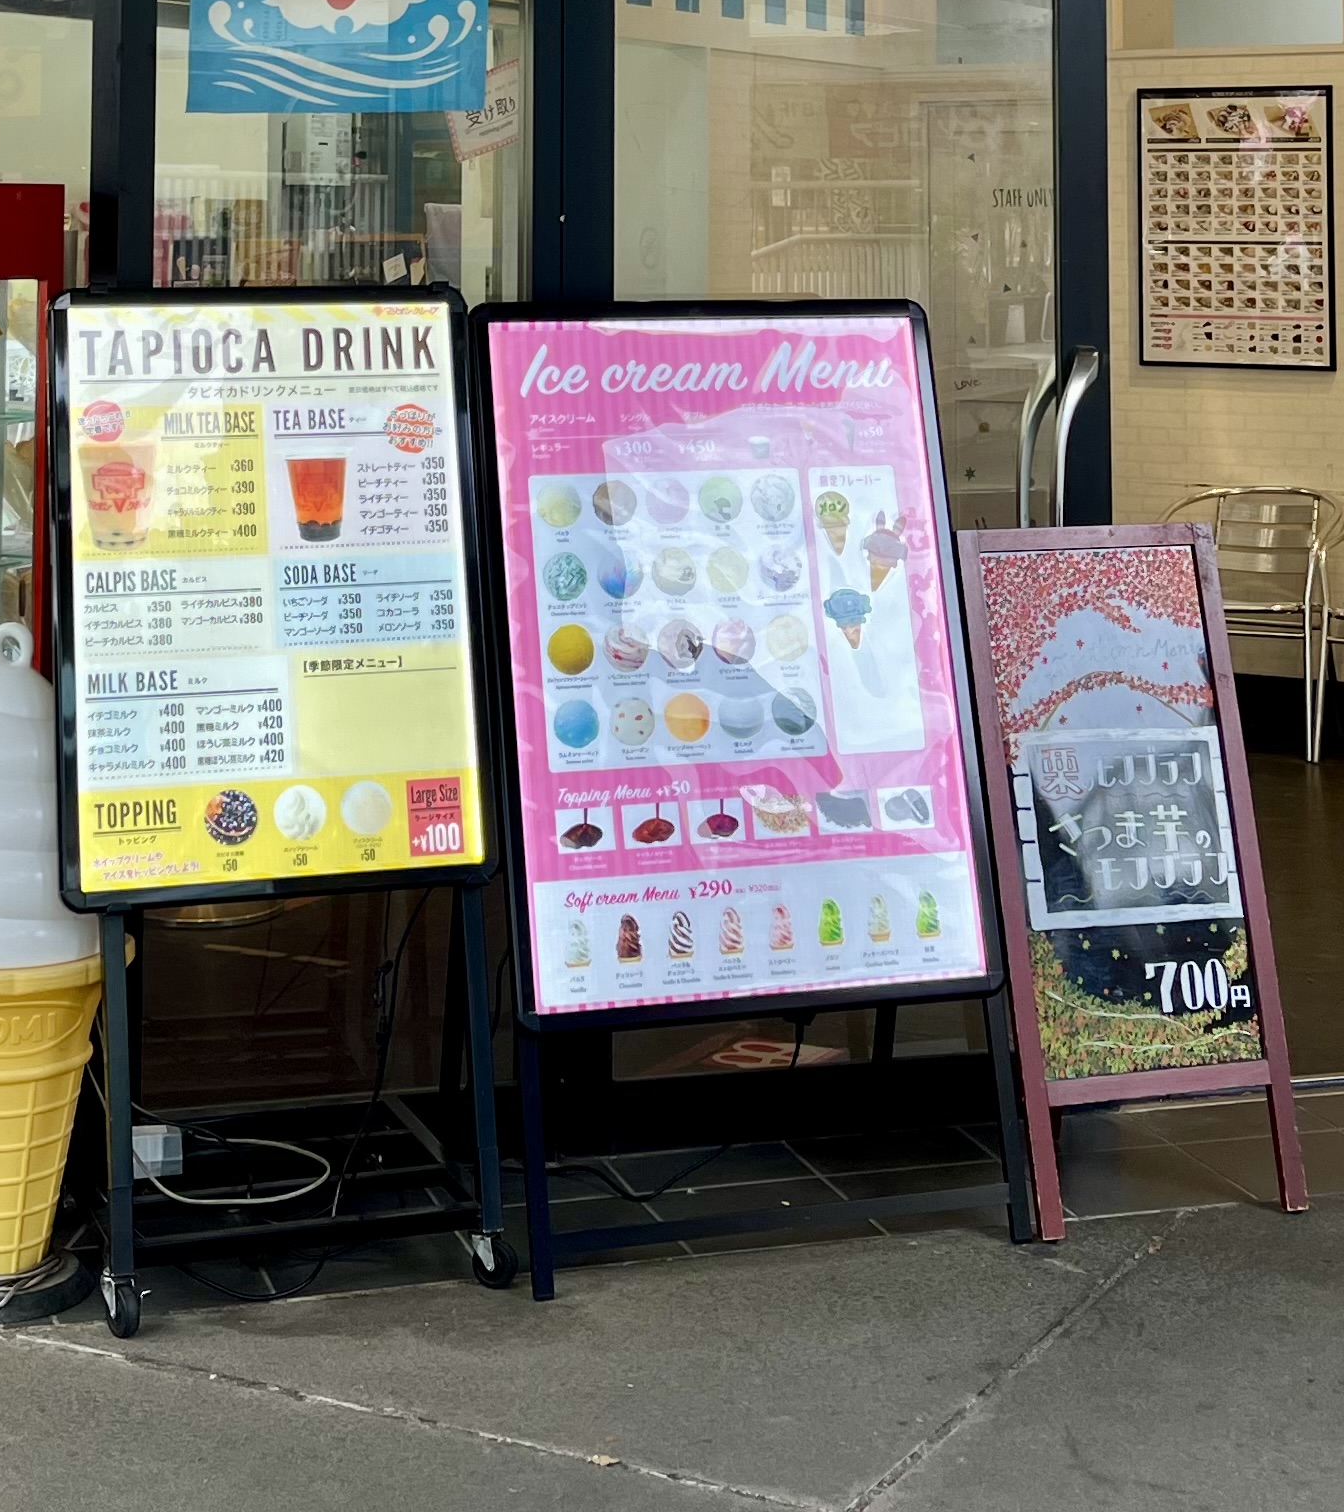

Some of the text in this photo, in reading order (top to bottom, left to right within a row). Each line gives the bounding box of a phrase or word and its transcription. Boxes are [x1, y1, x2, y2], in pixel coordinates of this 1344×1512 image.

[465, 96, 516, 128] 受け取り
[992, 188, 1022, 208] STAFF
[79, 326, 436, 375] TAPIOCA DRINK
[522, 341, 895, 398] Ice cream Menu
[187, 384, 337, 399] タピオカドリンクメニュー
[164, 411, 255, 434] MILK TEA BASE
[273, 408, 346, 431] TEA BASE
[529, 414, 596, 425] アイスクリーム
[230, 459, 254, 472] ¥360
[357, 456, 445, 473] ストレートティー ¥350
[422, 472, 446, 485] ¥350
[231, 480, 255, 494] ¥390
[358, 487, 447, 504] ライチティー ¥350
[232, 502, 256, 515] ¥390
[359, 503, 448, 519] マンゴーティー ¥350
[232, 524, 257, 537] ¥400
[360, 519, 449, 535] イチゴティー ¥350
[86, 569, 177, 594] CALPIS BASE
[284, 563, 357, 585] SODA BASE
[239, 596, 263, 608] ¥380
[338, 592, 362, 605] ¥350
[429, 589, 453, 601] ¥350
[147, 601, 172, 613] ¥350
[338, 607, 362, 619] ¥350
[376, 604, 454, 617] コカコーラ ¥350
[147, 617, 172, 629] ¥380
[239, 612, 263, 624] ¥380
[431, 619, 455, 631] ¥350
[284, 623, 363, 636] マンゴーソーダ ¥350
[148, 634, 173, 646] ¥380
[303, 655, 403, 673] 【季節限定メニュー】
[87, 670, 178, 695] MILK BASE
[87, 703, 185, 721] イチゴミルク ¥400
[195, 698, 283, 715] マンゴーミルク ¥400
[159, 720, 185, 734] ¥400
[258, 715, 283, 730] ¥420
[160, 738, 186, 752] ¥400
[258, 732, 284, 746] ¥400
[160, 755, 186, 770] ¥400
[259, 749, 285, 763] ¥420
[410, 784, 458, 807] Large Size
[557, 781, 691, 807] Topping Menu +¥50
[94, 799, 177, 829] TOPPING
[1048, 804, 1212, 857] さつま芋の
[292, 853, 308, 866] ¥50
[360, 848, 376, 861] ¥50
[222, 859, 238, 872] ¥50
[1095, 851, 1229, 891] モンブラン
[564, 892, 594, 917] Soft
[596, 890, 638, 905] cream
[642, 887, 680, 901] Menu
[688, 879, 733, 899] ¥290
[1143, 958, 1252, 1015] 700円
